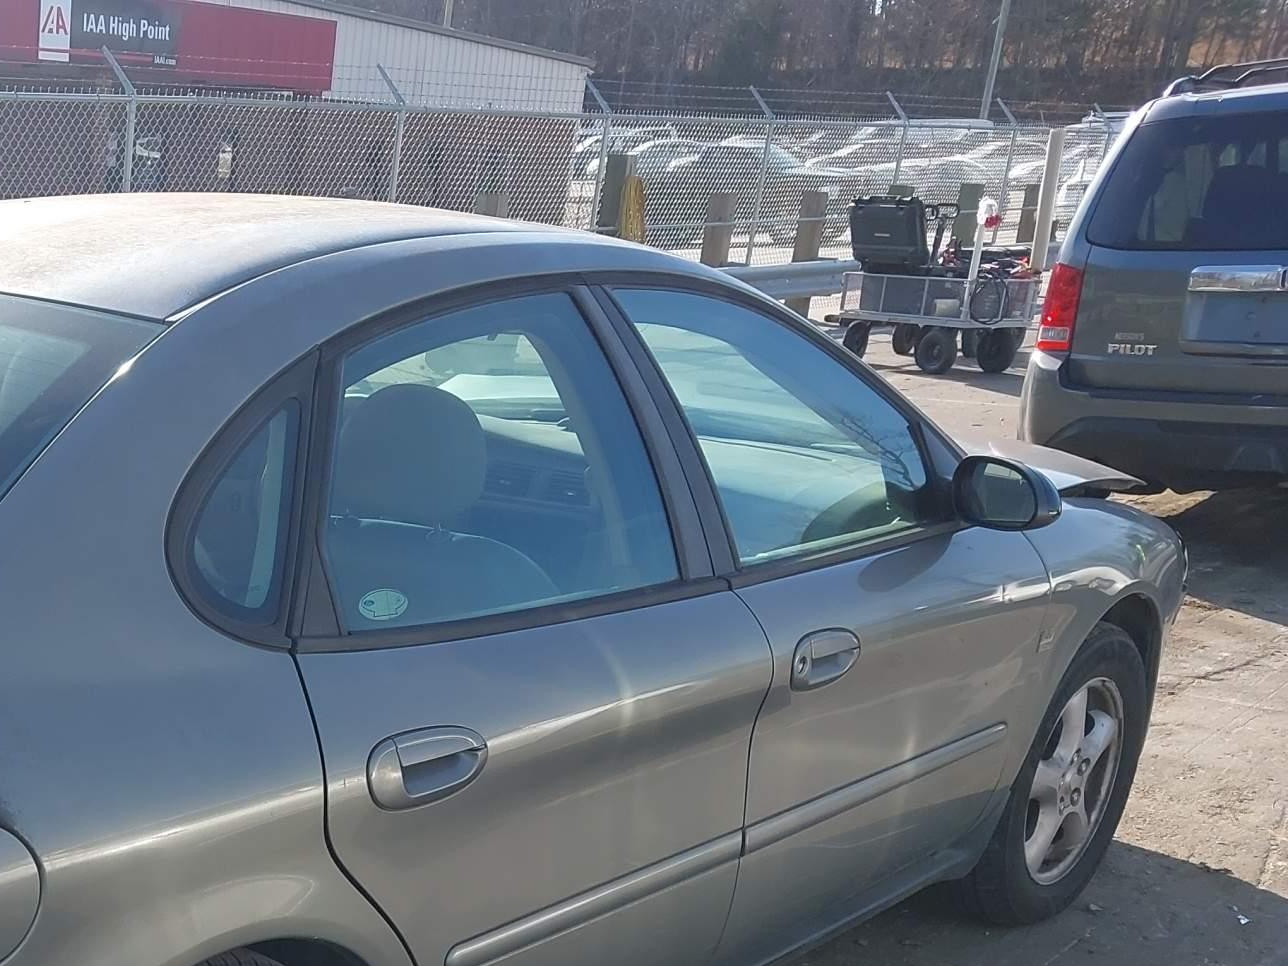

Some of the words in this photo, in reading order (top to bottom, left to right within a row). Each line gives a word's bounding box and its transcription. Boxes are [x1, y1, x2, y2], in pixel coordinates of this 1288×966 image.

[83, 12, 106, 34] IAA
[109, 15, 137, 41] High
[139, 19, 170, 41] Point
[1108, 343, 1158, 356] PILOT
